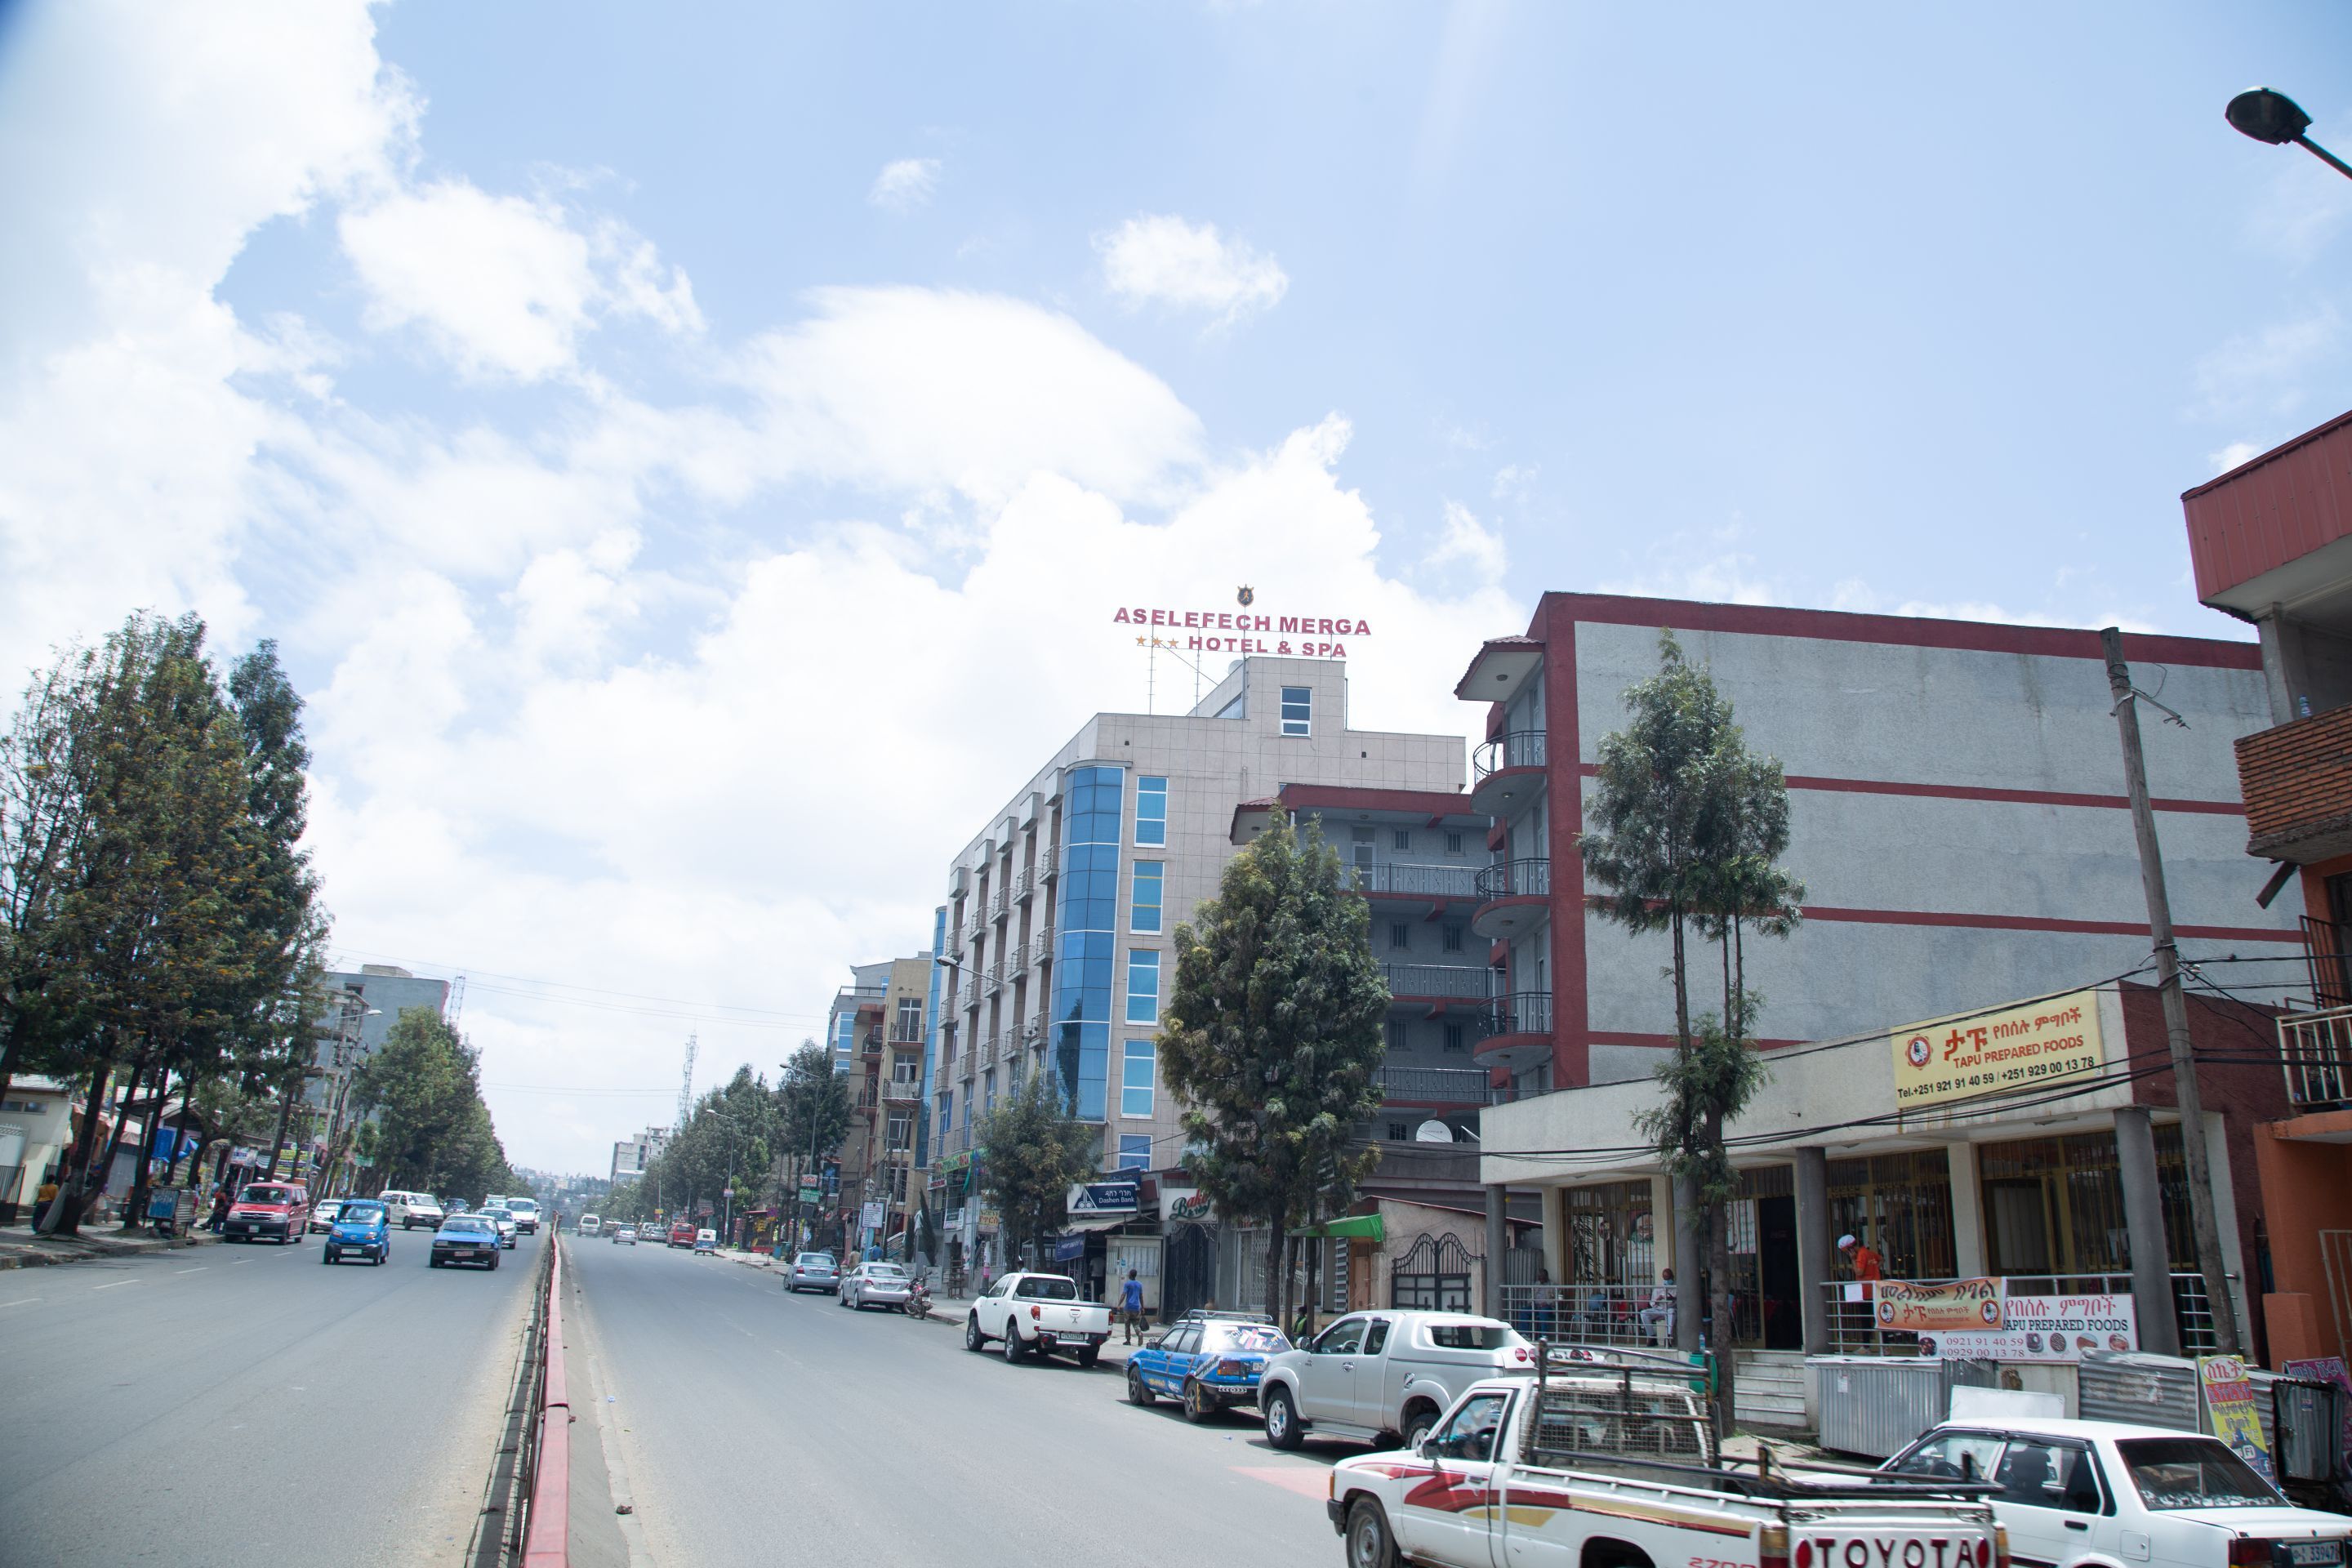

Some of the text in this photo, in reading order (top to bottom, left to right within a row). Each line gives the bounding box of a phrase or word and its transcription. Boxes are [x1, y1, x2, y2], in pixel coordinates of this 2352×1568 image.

[1113, 607, 1371, 635] ASELEFECH MERGA
[1188, 635, 1347, 657] HOTEL & SPA
[1953, 1035, 2084, 1069] TAPU PREPARED FOODS
[1936, 1080, 1952, 1092] 921
[1954, 1077, 1966, 1089] 91
[1968, 1075, 1980, 1086] 40
[1983, 1072, 1994, 1085] 59
[2002, 1067, 2025, 1080] +251
[2027, 1063, 2047, 1076] 929
[2049, 1061, 2062, 1073] 00
[2065, 1058, 2078, 1071] 13
[2080, 1056, 2095, 1068] 78
[1881, 1285, 1946, 1302] መልካም
[2029, 1319, 2085, 1331] PREPARED
[2087, 1319, 2128, 1331] FOODS
[1946, 1338, 2025, 1346] 0921 91 40 59
[1947, 1349, 1973, 1358] 0929
[1976, 1349, 1989, 1357] 00
[1994, 1349, 2007, 1357] 13
[2011, 1349, 2025, 1358] 78
[1815, 1538, 1976, 1568] TOYOTA
